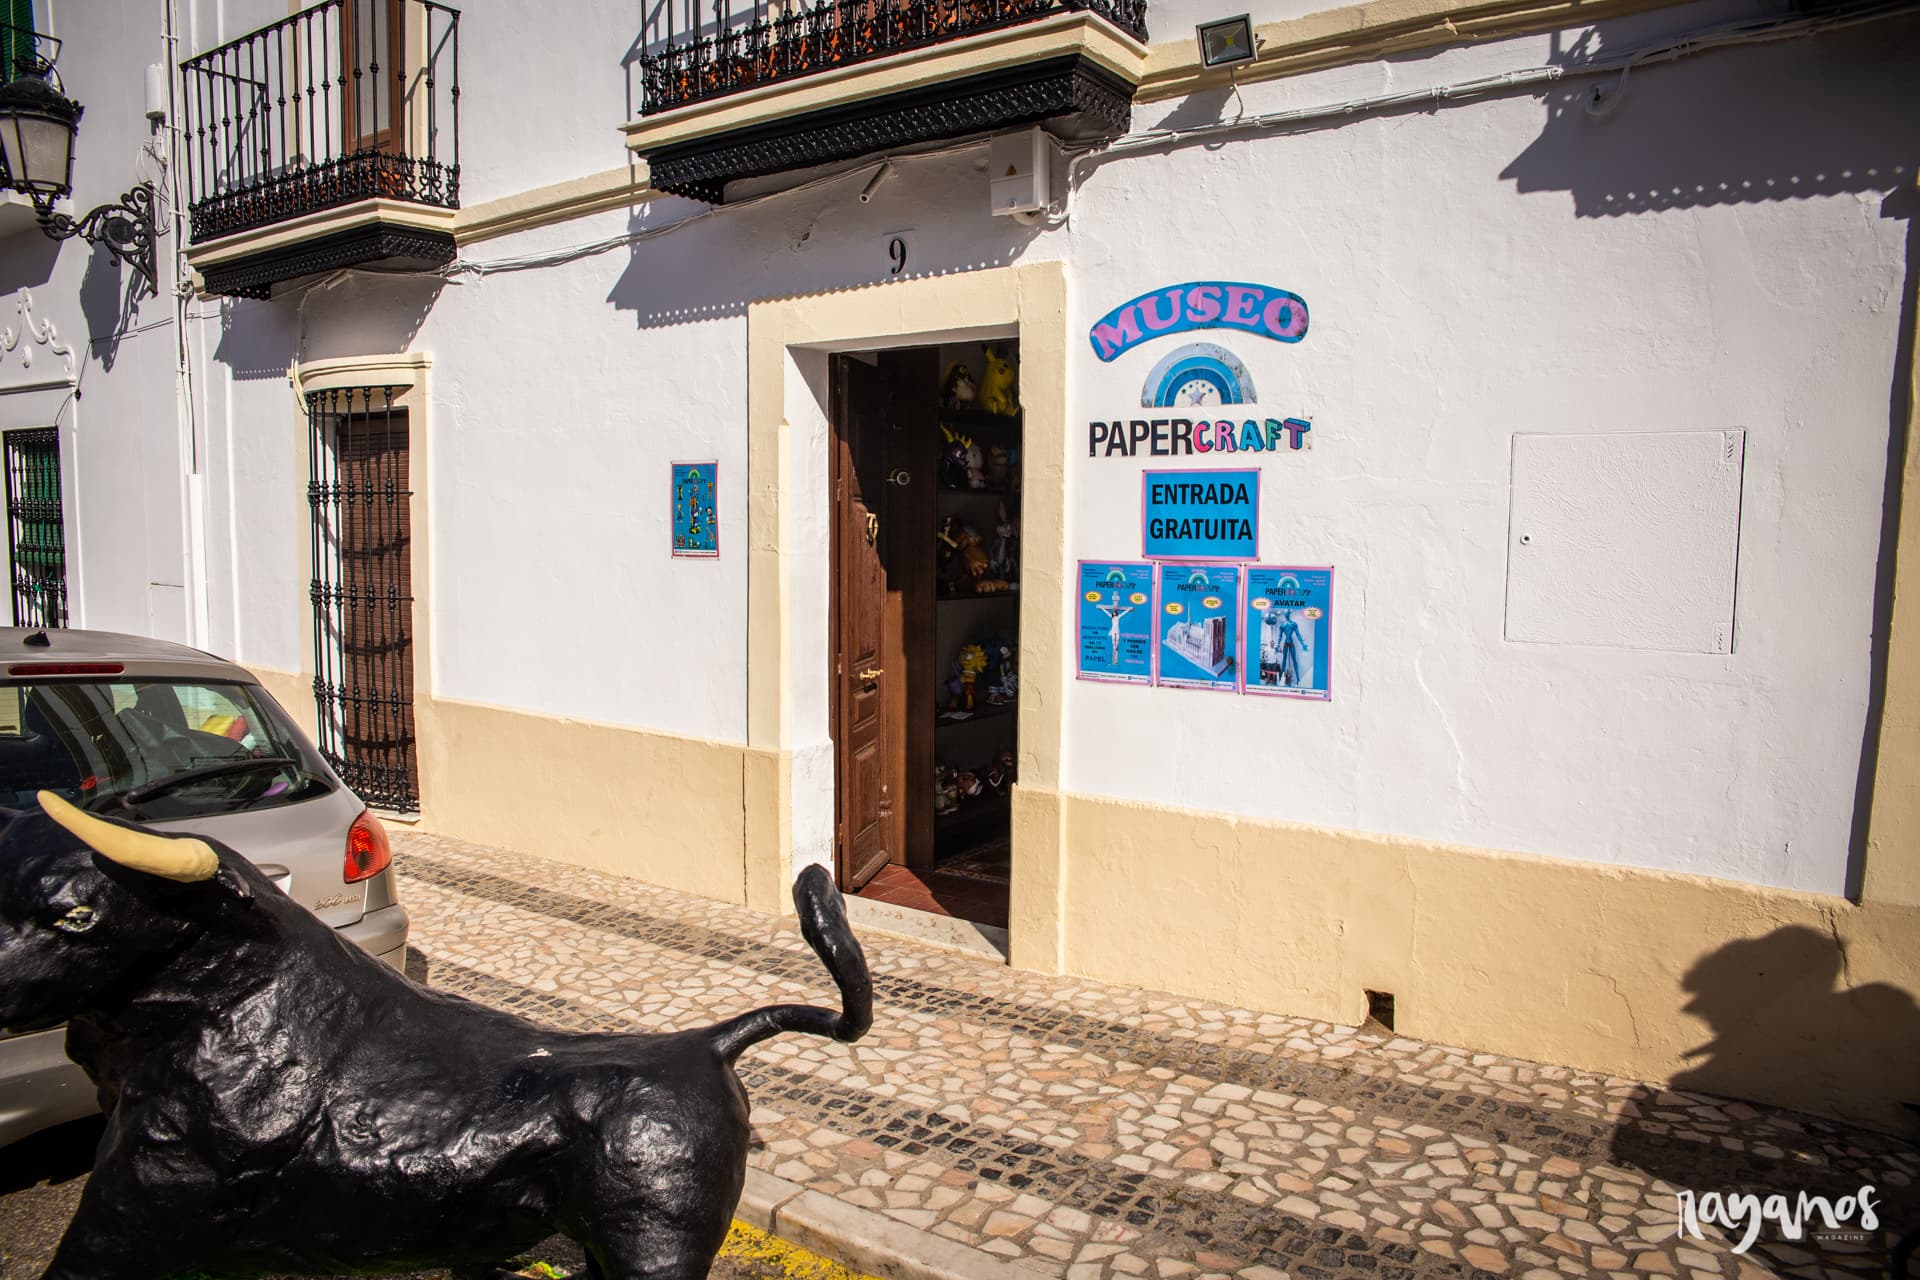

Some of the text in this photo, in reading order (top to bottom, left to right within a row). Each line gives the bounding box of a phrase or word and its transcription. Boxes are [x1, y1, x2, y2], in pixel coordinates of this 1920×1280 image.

[889, 238, 906, 274] 9
[1090, 285, 1308, 359] MUSEO
[1089, 417, 1311, 457] PAPERCRAFT
[1151, 483, 1249, 505] ENTRADA
[1150, 518, 1253, 540] GRATUITA
[1274, 599, 1305, 607] AVATAR
